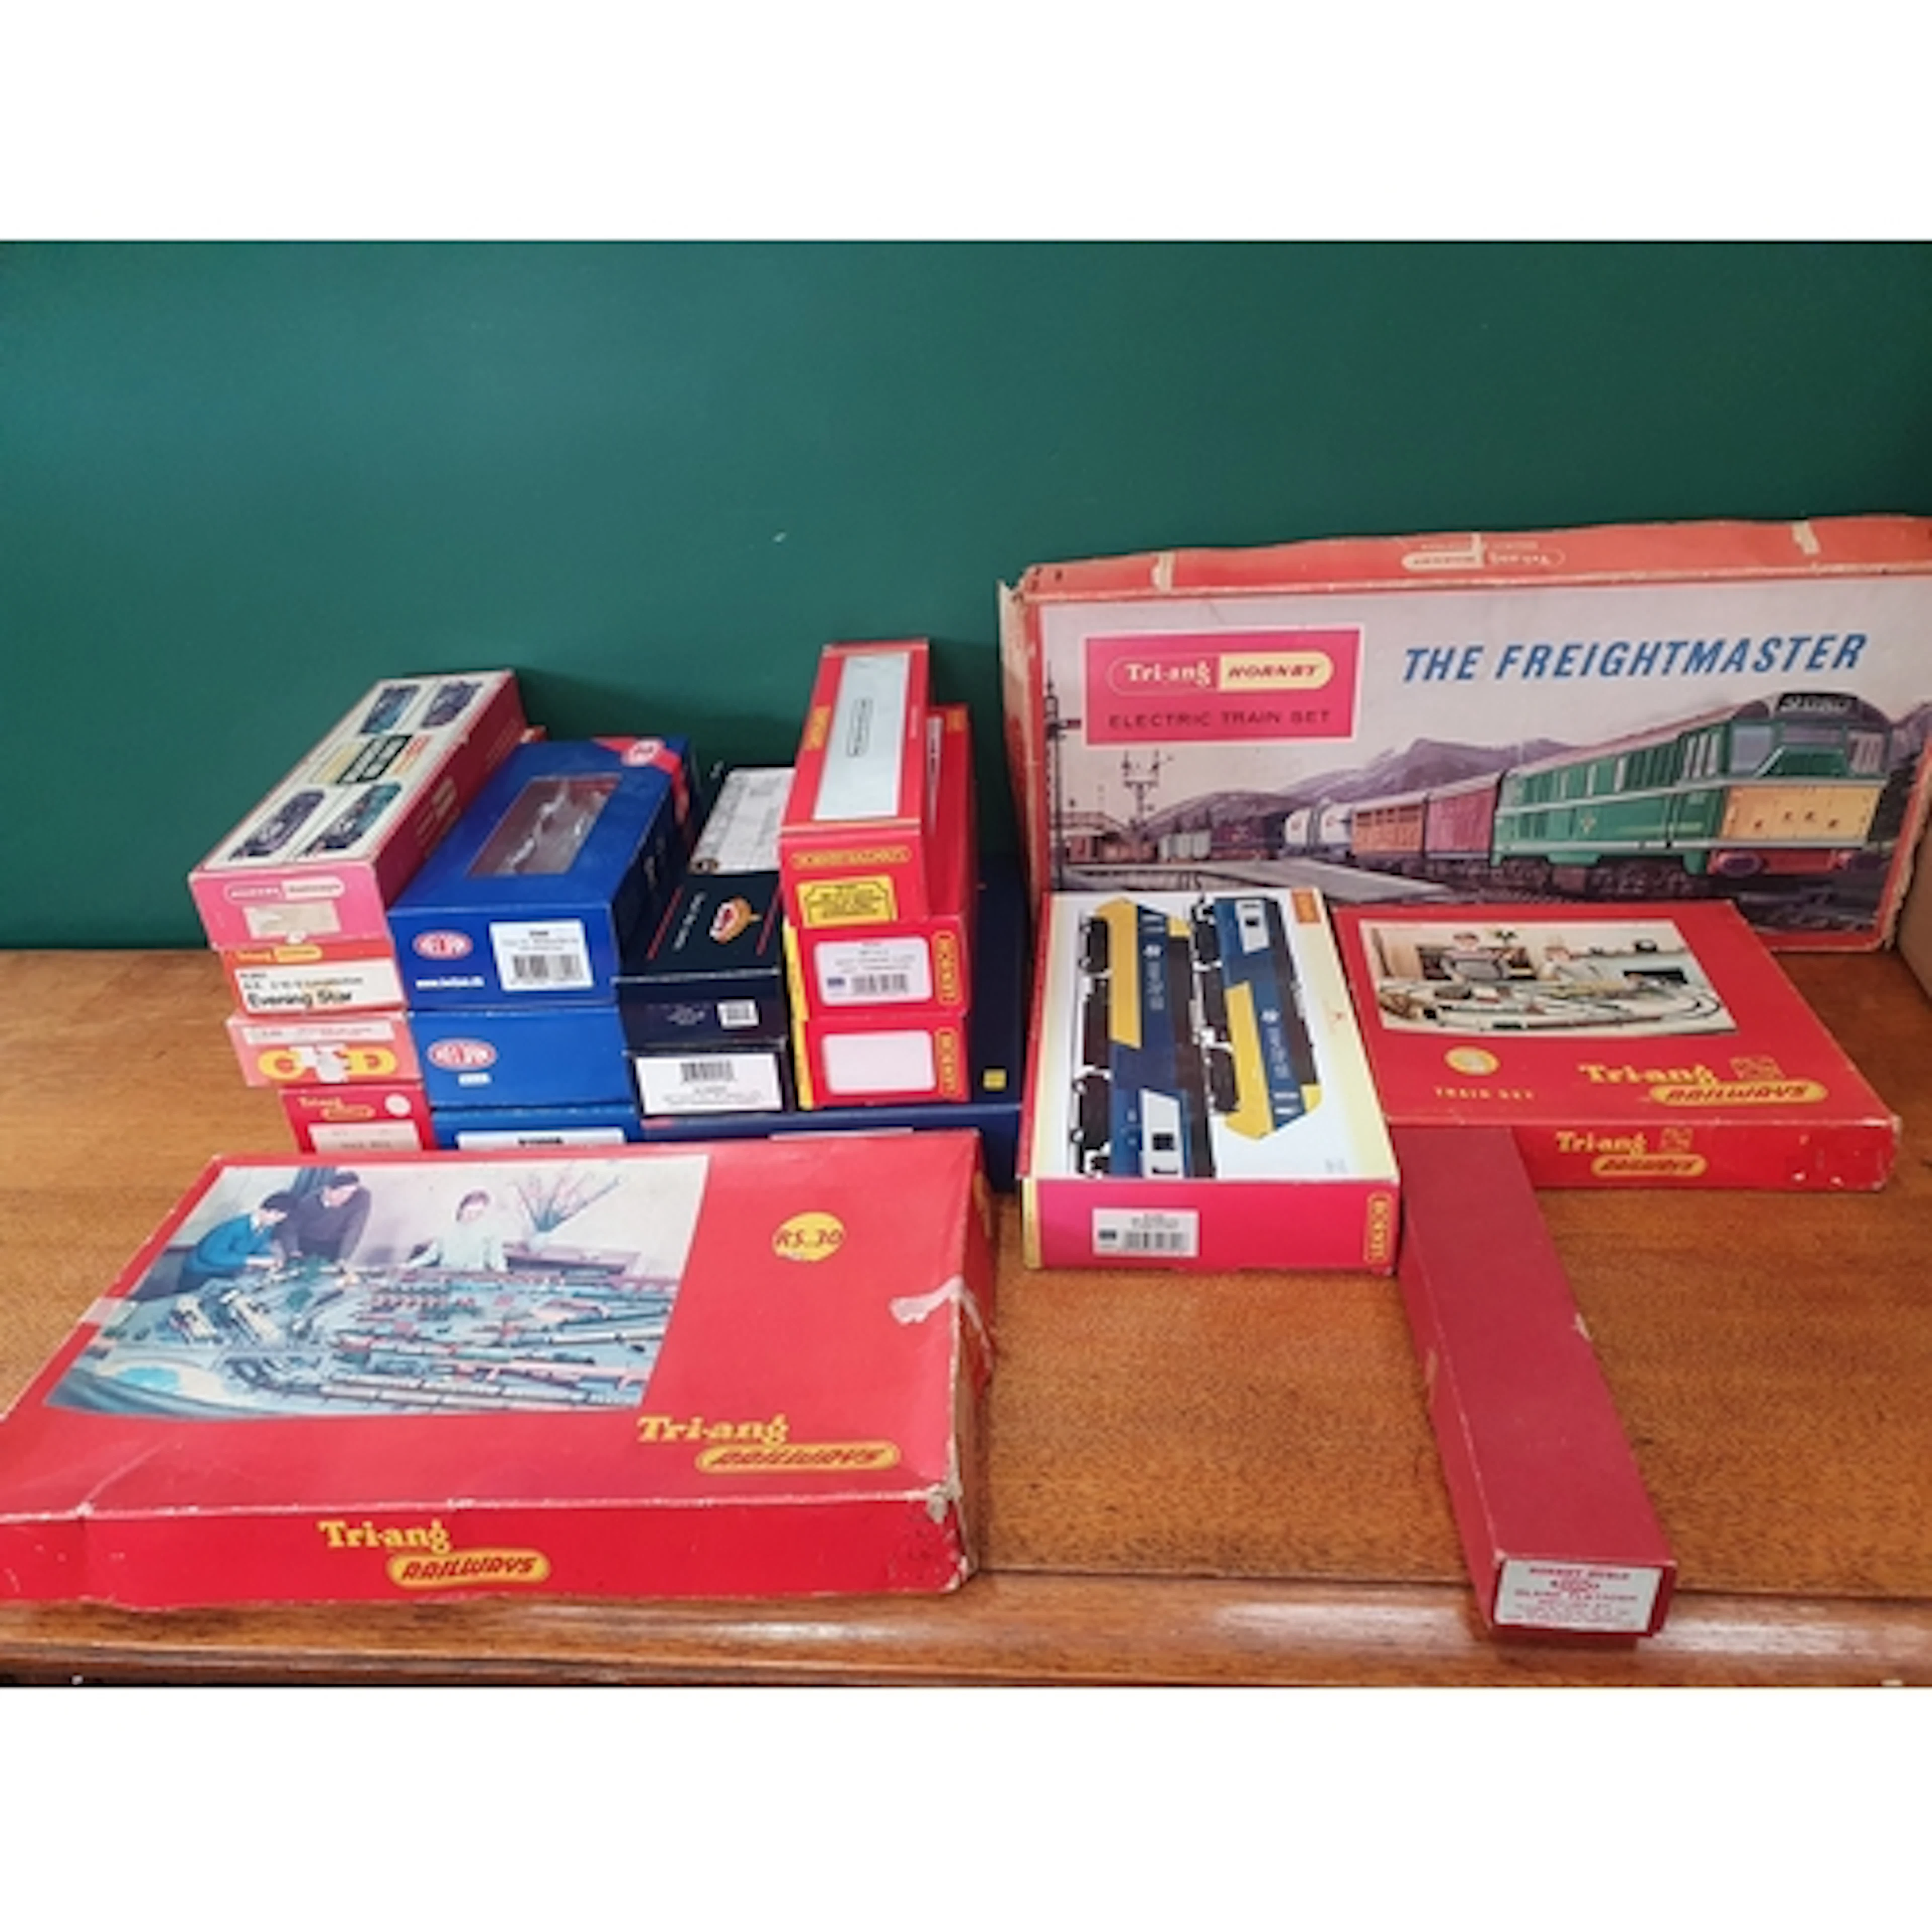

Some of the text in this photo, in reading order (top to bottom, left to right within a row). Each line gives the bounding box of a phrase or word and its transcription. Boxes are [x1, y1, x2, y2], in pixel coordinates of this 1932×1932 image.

[1402, 633, 1867, 682] THE FREIGHTMASTER
[1228, 664, 1320, 680] HORNBY
[1109, 709, 1331, 730] ELECTRIC TRAIN SET
[248, 990, 313, 1008] Evening
[401, 1556, 537, 1580] RAILWAYS
